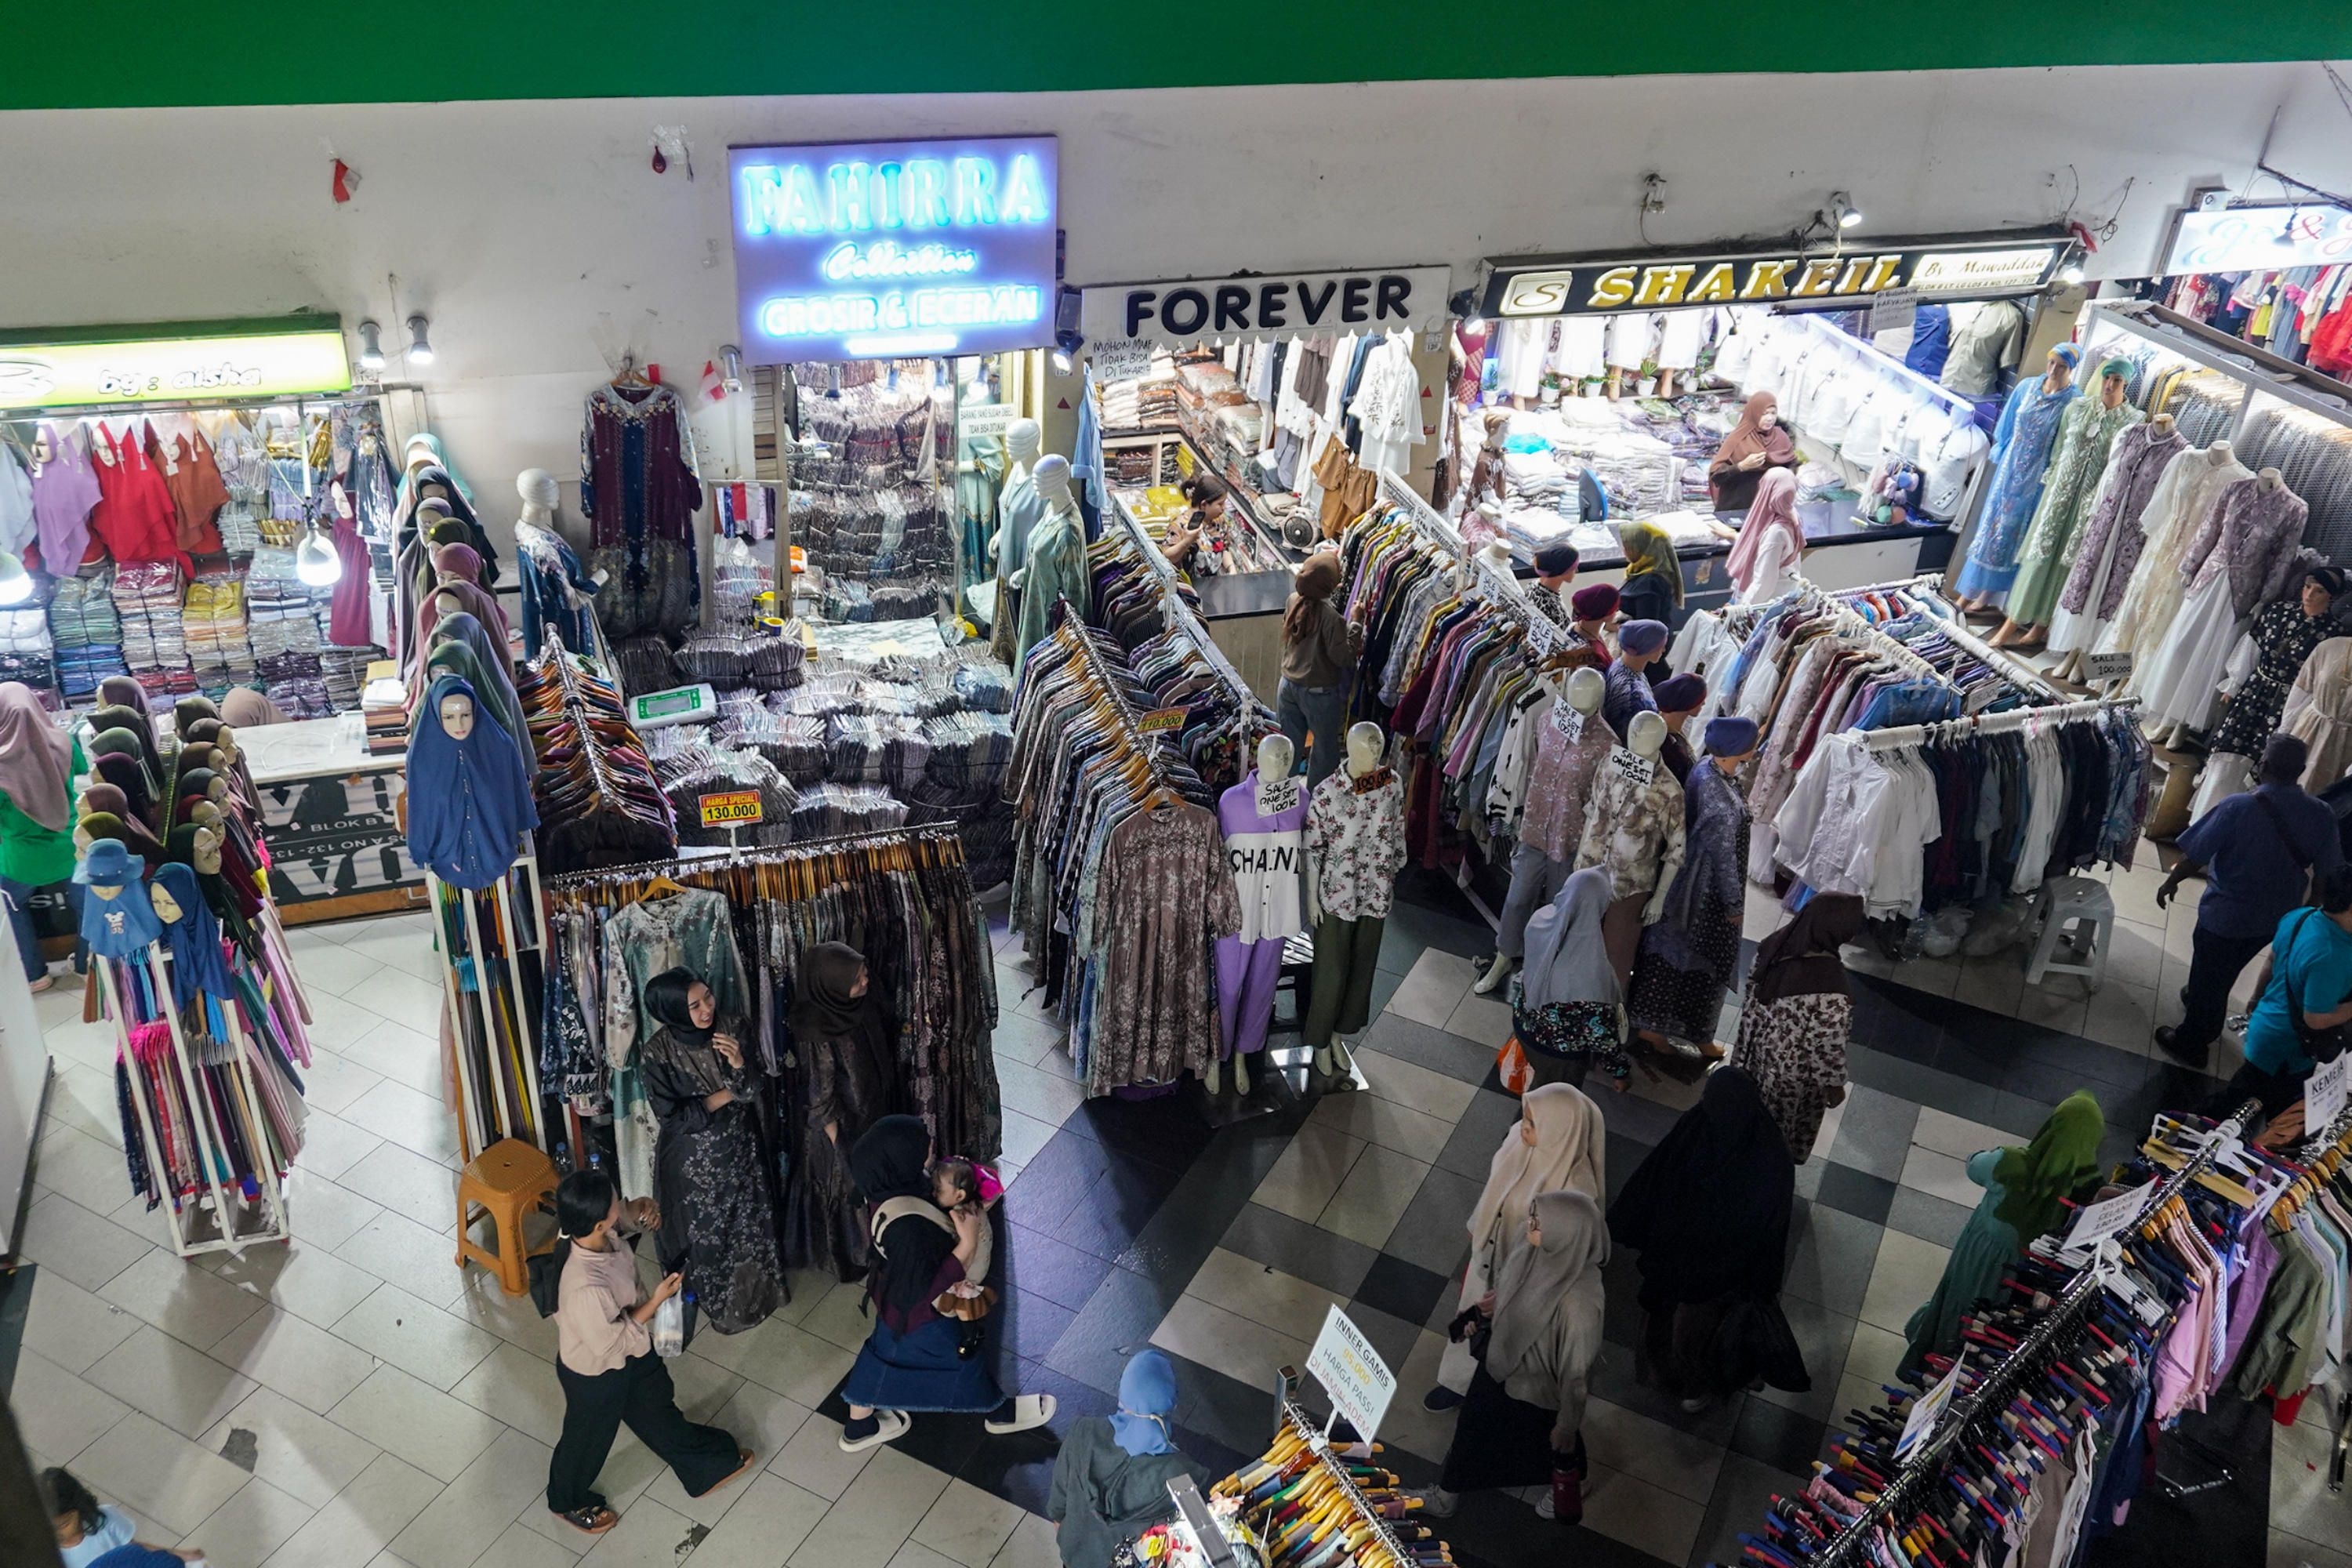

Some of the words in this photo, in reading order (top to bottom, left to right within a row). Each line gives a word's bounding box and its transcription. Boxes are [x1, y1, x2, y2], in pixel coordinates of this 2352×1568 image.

[742, 154, 1049, 235] FAHIRRA
[823, 241, 977, 281] Collection
[1960, 256, 2049, 274] Mawaddah
[1588, 255, 1904, 307] SHAKEIL
[764, 295, 878, 337] GROSIR
[884, 292, 910, 329] &
[916, 286, 1040, 328] ECERAN
[1127, 275, 1411, 338] FOREVER
[1093, 340, 1131, 353] MOHON
[1099, 353, 1127, 365] TIDAK
[1130, 353, 1148, 364] BISA
[172, 361, 261, 390] aisha
[1533, 616, 1551, 639] SALE
[1530, 631, 1547, 652] 50K
[1560, 702, 1577, 719] SALE
[1558, 720, 1575, 739] 100K
[1621, 750, 1646, 766] SALE
[1622, 768, 1650, 785] 100K
[1265, 781, 1290, 796] SALE
[706, 796, 728, 807] HARGA
[729, 794, 755, 805] SPECIAL
[1272, 798, 1297, 813] 100K
[707, 804, 757, 820] 130.000
[311, 819, 361, 832] BLOK
[365, 817, 378, 826] B
[307, 844, 335, 855] 132
[341, 840, 367, 850] NO
[1335, 1316, 1363, 1352] INNER
[1363, 1348, 1390, 1388] GAMIS
[1323, 1348, 1351, 1388] HARGA
[1342, 1348, 1371, 1386] 95.000
